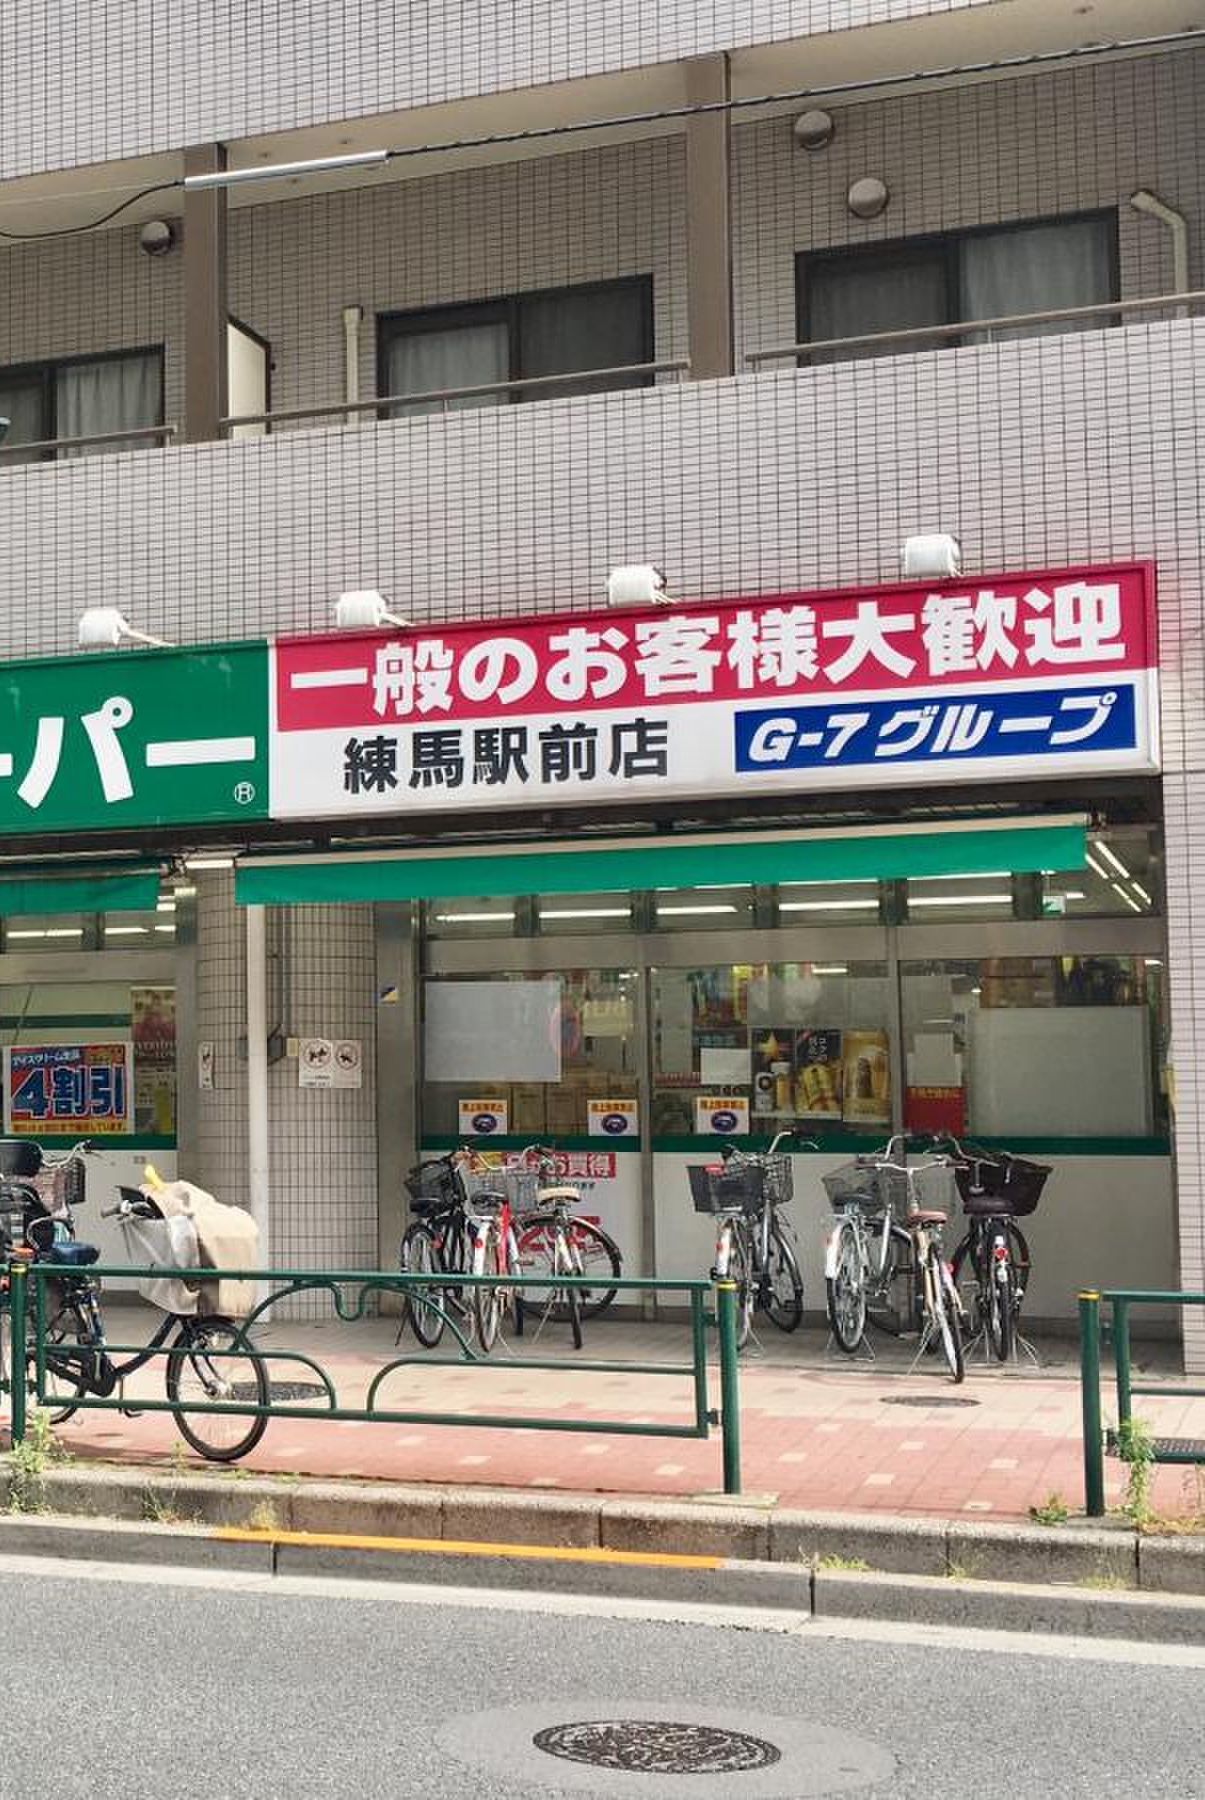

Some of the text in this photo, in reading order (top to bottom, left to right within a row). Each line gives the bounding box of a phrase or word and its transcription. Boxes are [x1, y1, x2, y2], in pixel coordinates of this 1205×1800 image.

[290, 581, 1126, 719] 一般のお客様大歓迎
[343, 718, 669, 795] 練馬駅前店
[748, 691, 1118, 763] G-7 グループ
[10, 1065, 125, 1118] 4割引
